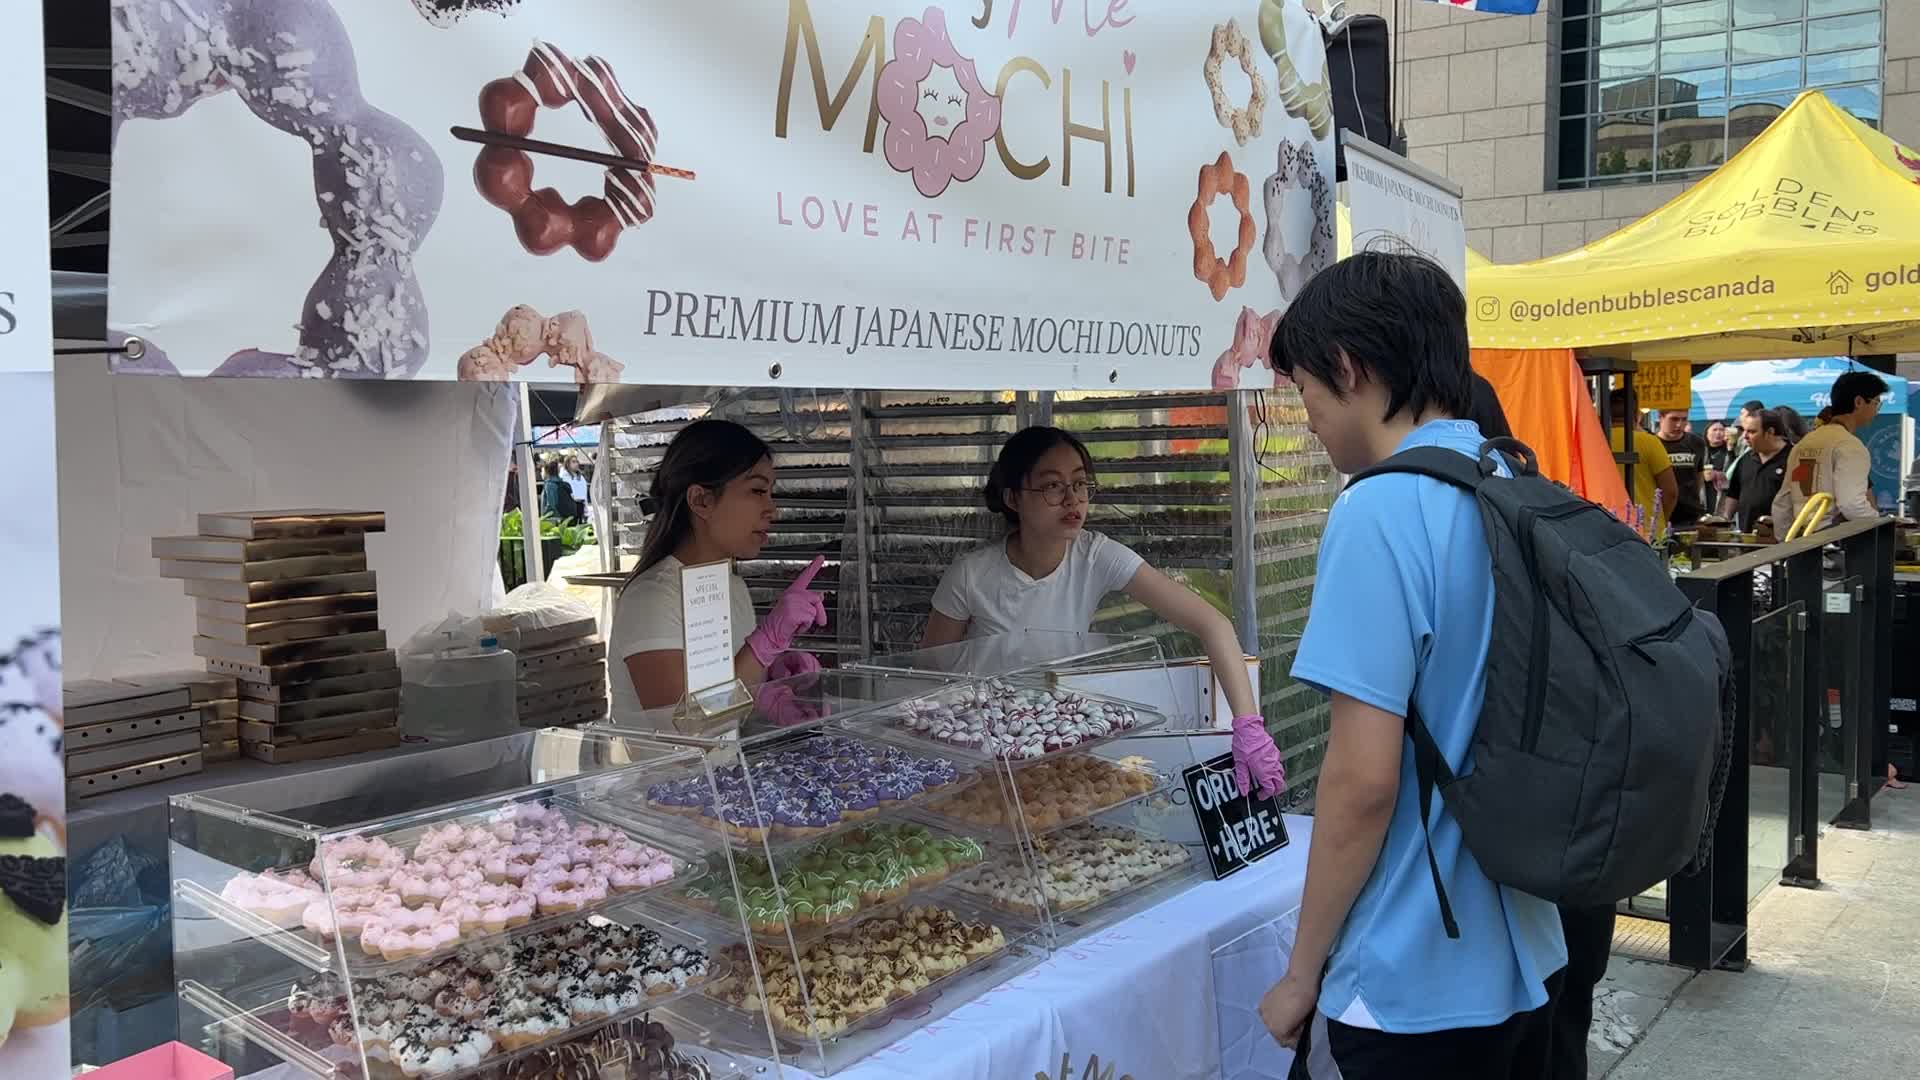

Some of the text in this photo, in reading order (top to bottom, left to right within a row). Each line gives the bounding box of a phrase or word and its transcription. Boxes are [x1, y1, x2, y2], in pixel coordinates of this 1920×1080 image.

[776, 191, 1131, 265] LOVE AT FIRST BITE
[643, 289, 1201, 357] PREMIUM JAPANESE MOCHI DONUTS
[1509, 275, 1776, 322] @goldenbubblescanada
[1195, 768, 1261, 812] ORD
[1218, 809, 1277, 863] HERE
